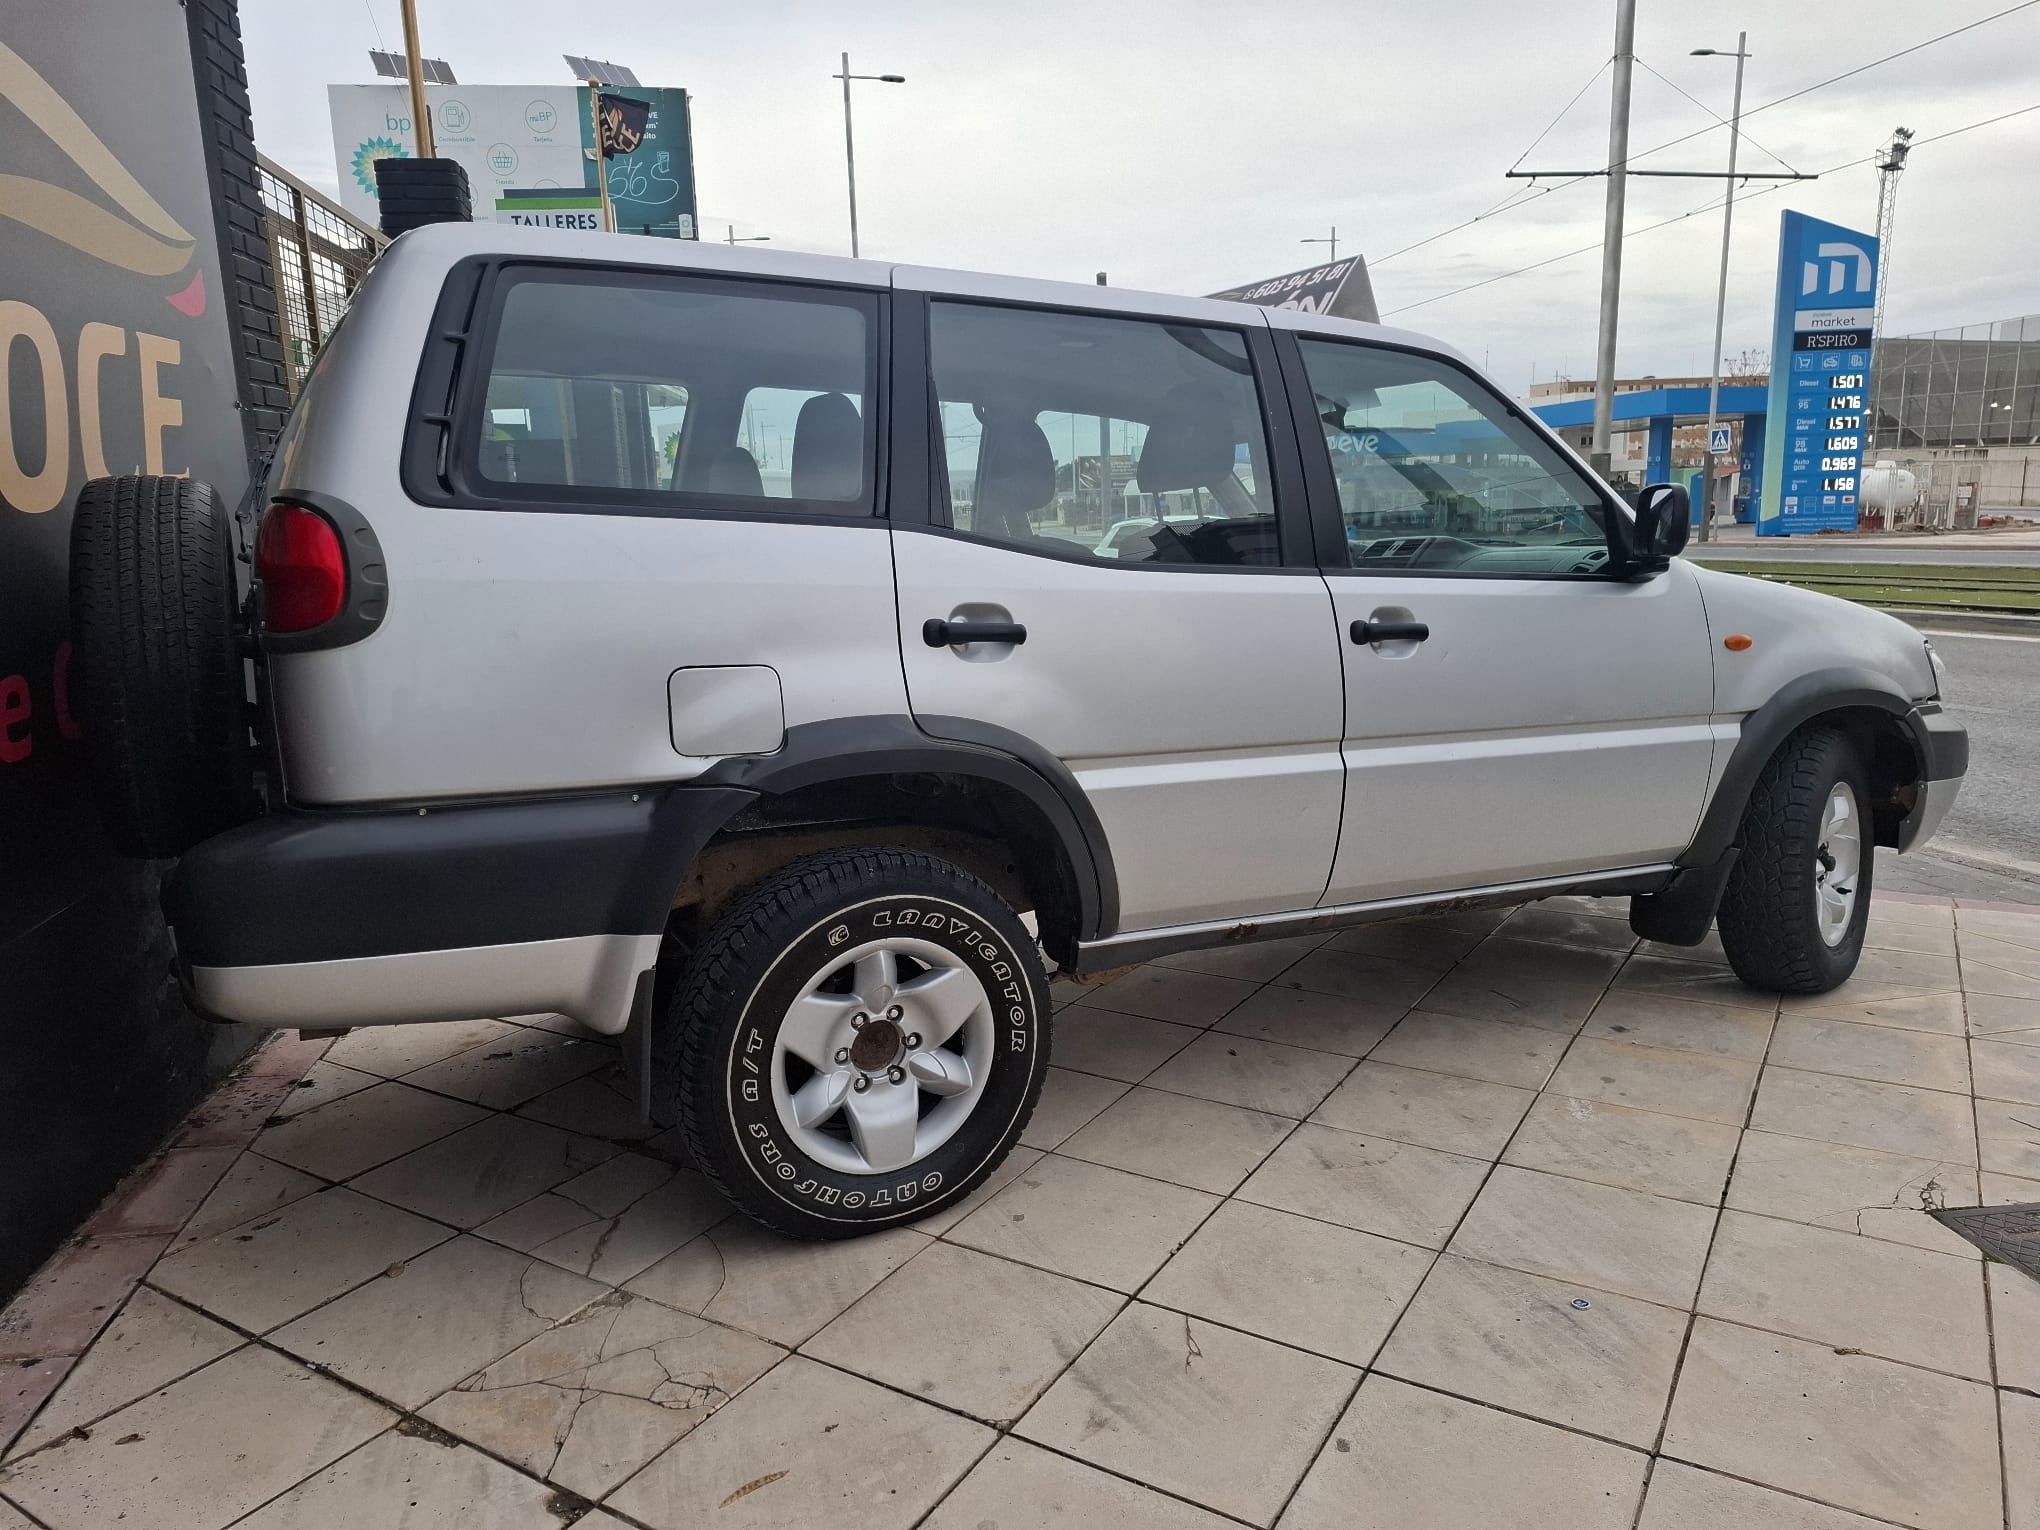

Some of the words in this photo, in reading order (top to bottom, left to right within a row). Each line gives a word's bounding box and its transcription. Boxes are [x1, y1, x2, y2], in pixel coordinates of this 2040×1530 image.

[386, 113, 412, 135] bp
[1253, 278, 1288, 299] 603
[1283, 273, 1311, 292] 94
[1306, 267, 1331, 286] 51
[1325, 262, 1351, 281] 81
[1811, 316, 1856, 327] market
[1807, 334, 1858, 348] R'SPIRO
[1833, 374, 1864, 389] 1.507
[1831, 395, 1861, 410] 1.476
[1829, 416, 1860, 430] 1.577
[1828, 436, 1858, 451] 1.609
[1821, 457, 1857, 472] 0.969
[1824, 477, 1855, 491] 1.158
[872, 908, 1027, 1053] LANVIGATOR
[741, 1027, 764, 1102] A/T
[748, 1122, 944, 1209] CATCHFORS
